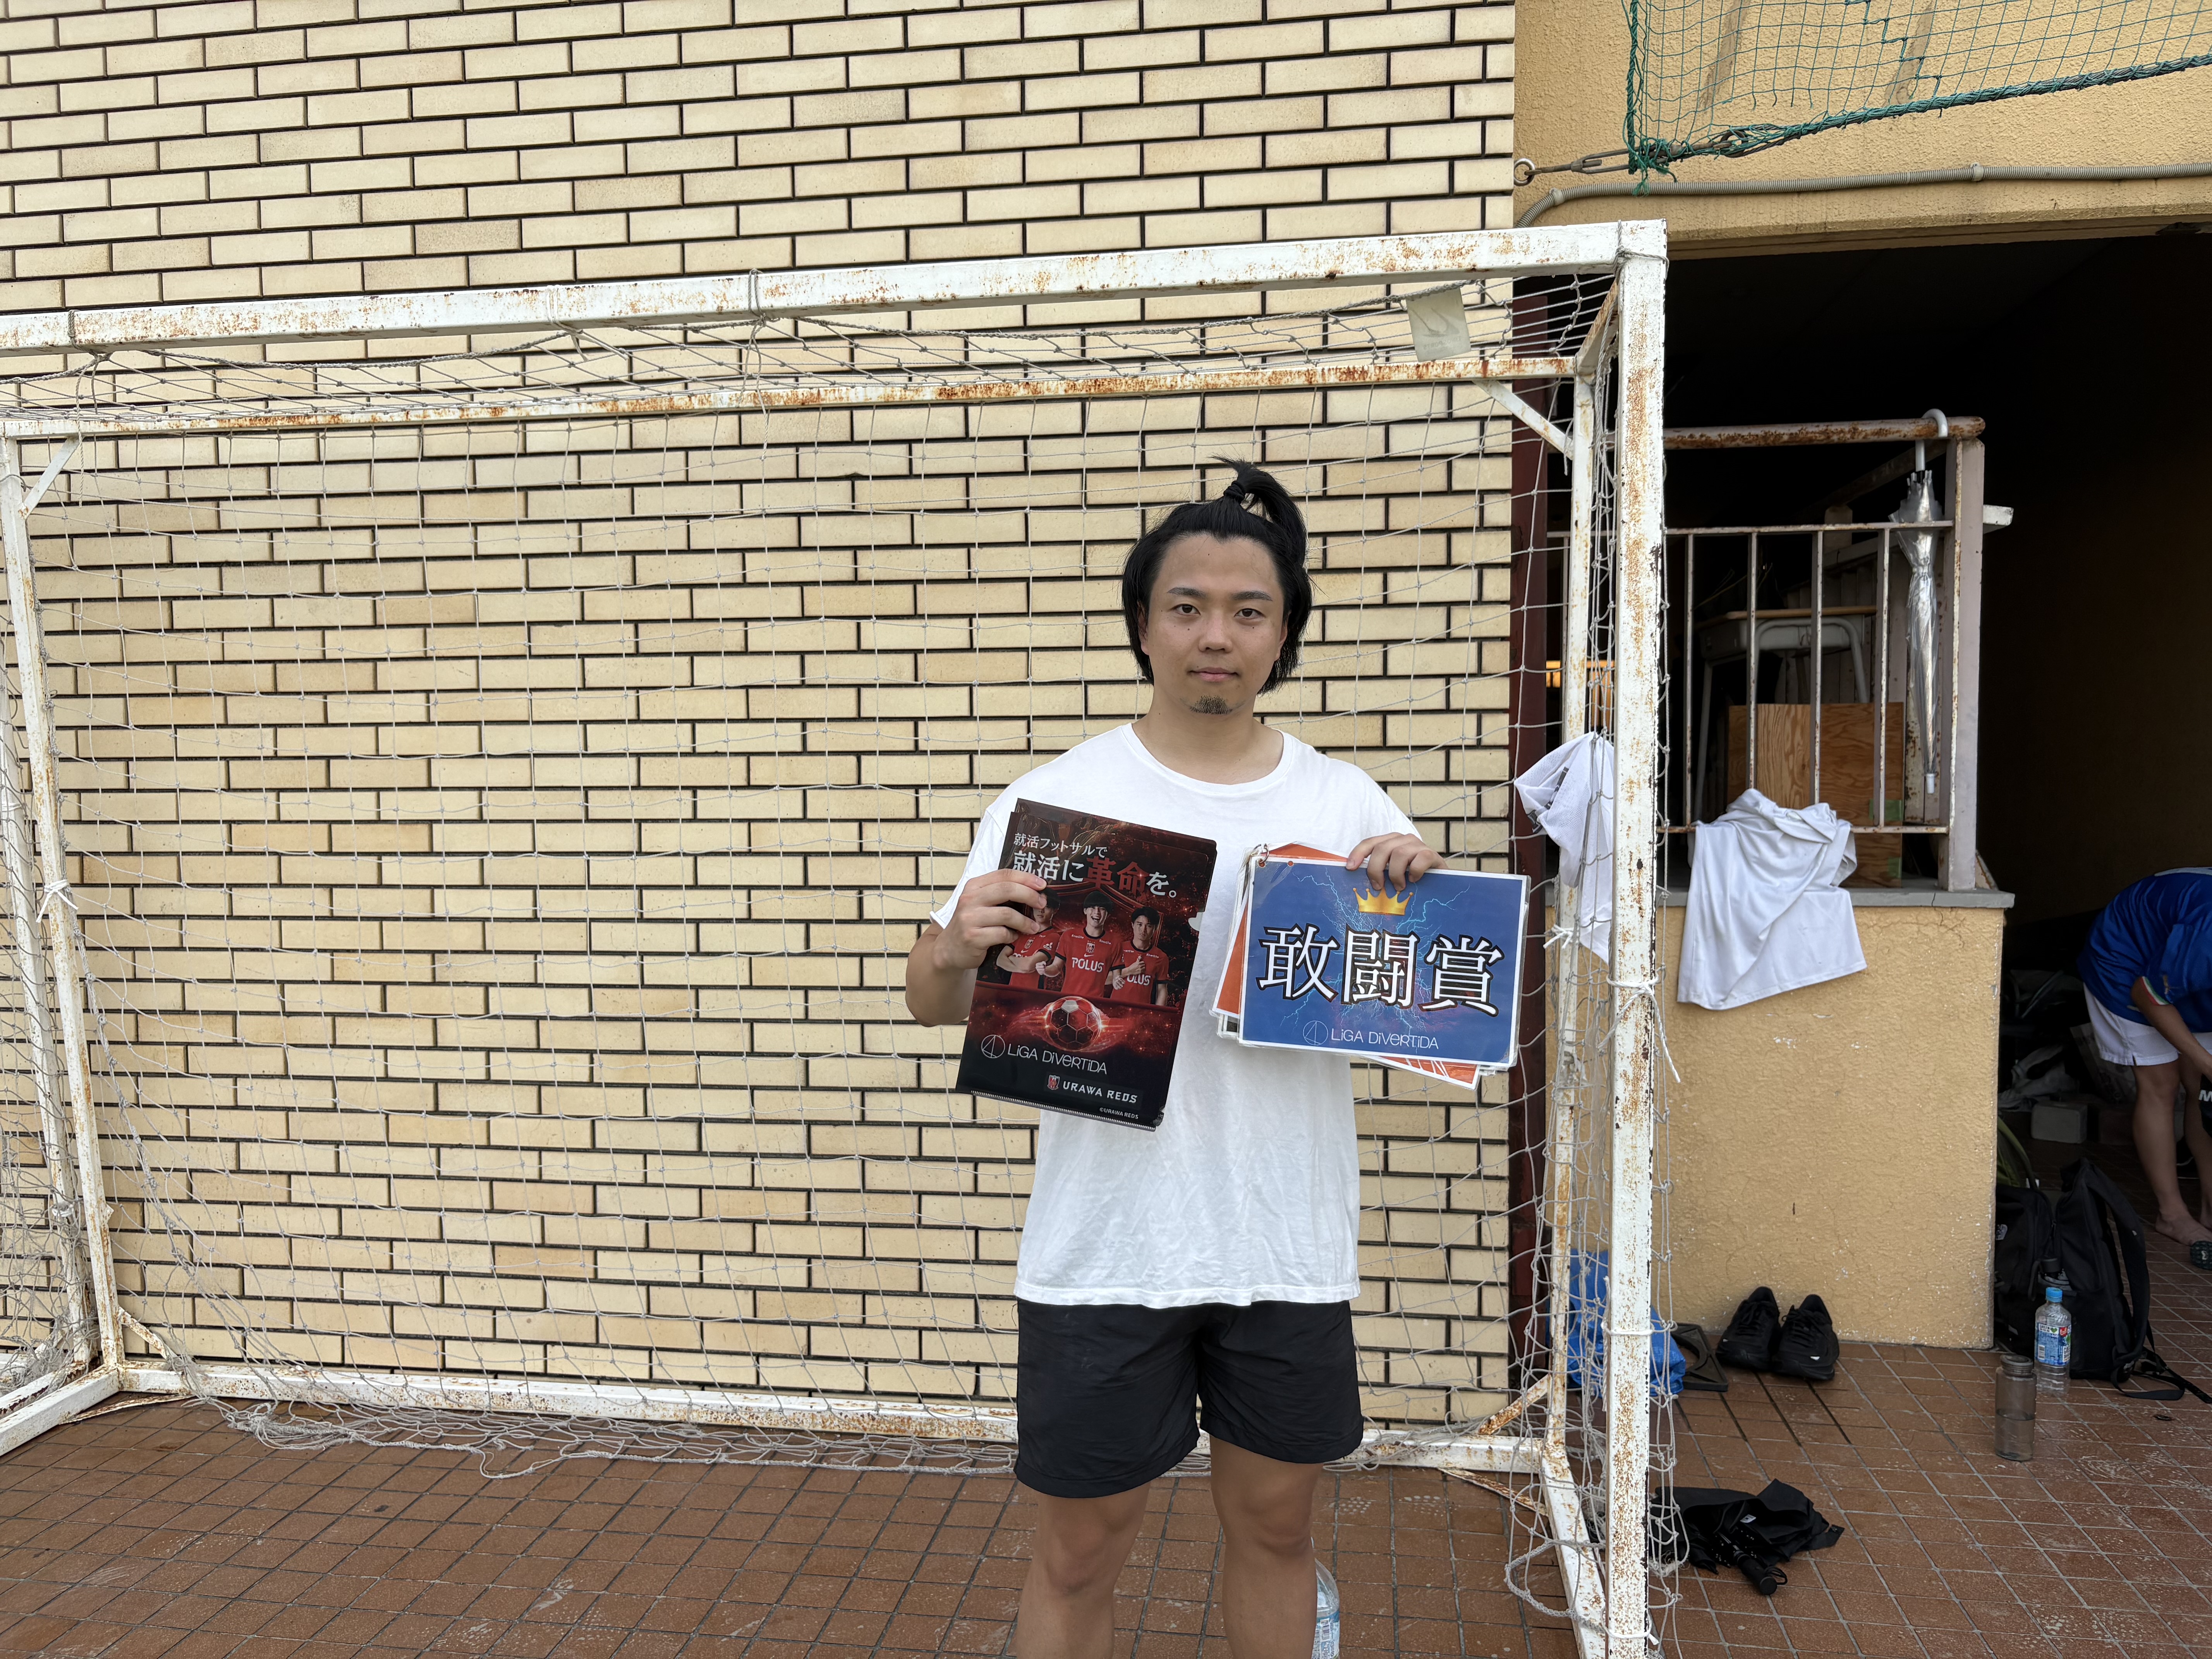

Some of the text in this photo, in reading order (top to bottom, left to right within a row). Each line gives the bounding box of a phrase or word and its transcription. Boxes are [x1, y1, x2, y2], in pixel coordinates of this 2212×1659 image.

[1013, 832, 1108, 858] 就活フットサルで
[1013, 850, 1177, 898] 就活に革命を。
[1072, 957, 1104, 973] POLUS
[1256, 922, 1505, 1018] 敢闘賞
[1127, 974, 1151, 986] OLUS
[1063, 1081, 1138, 1103] URAWA REDS
